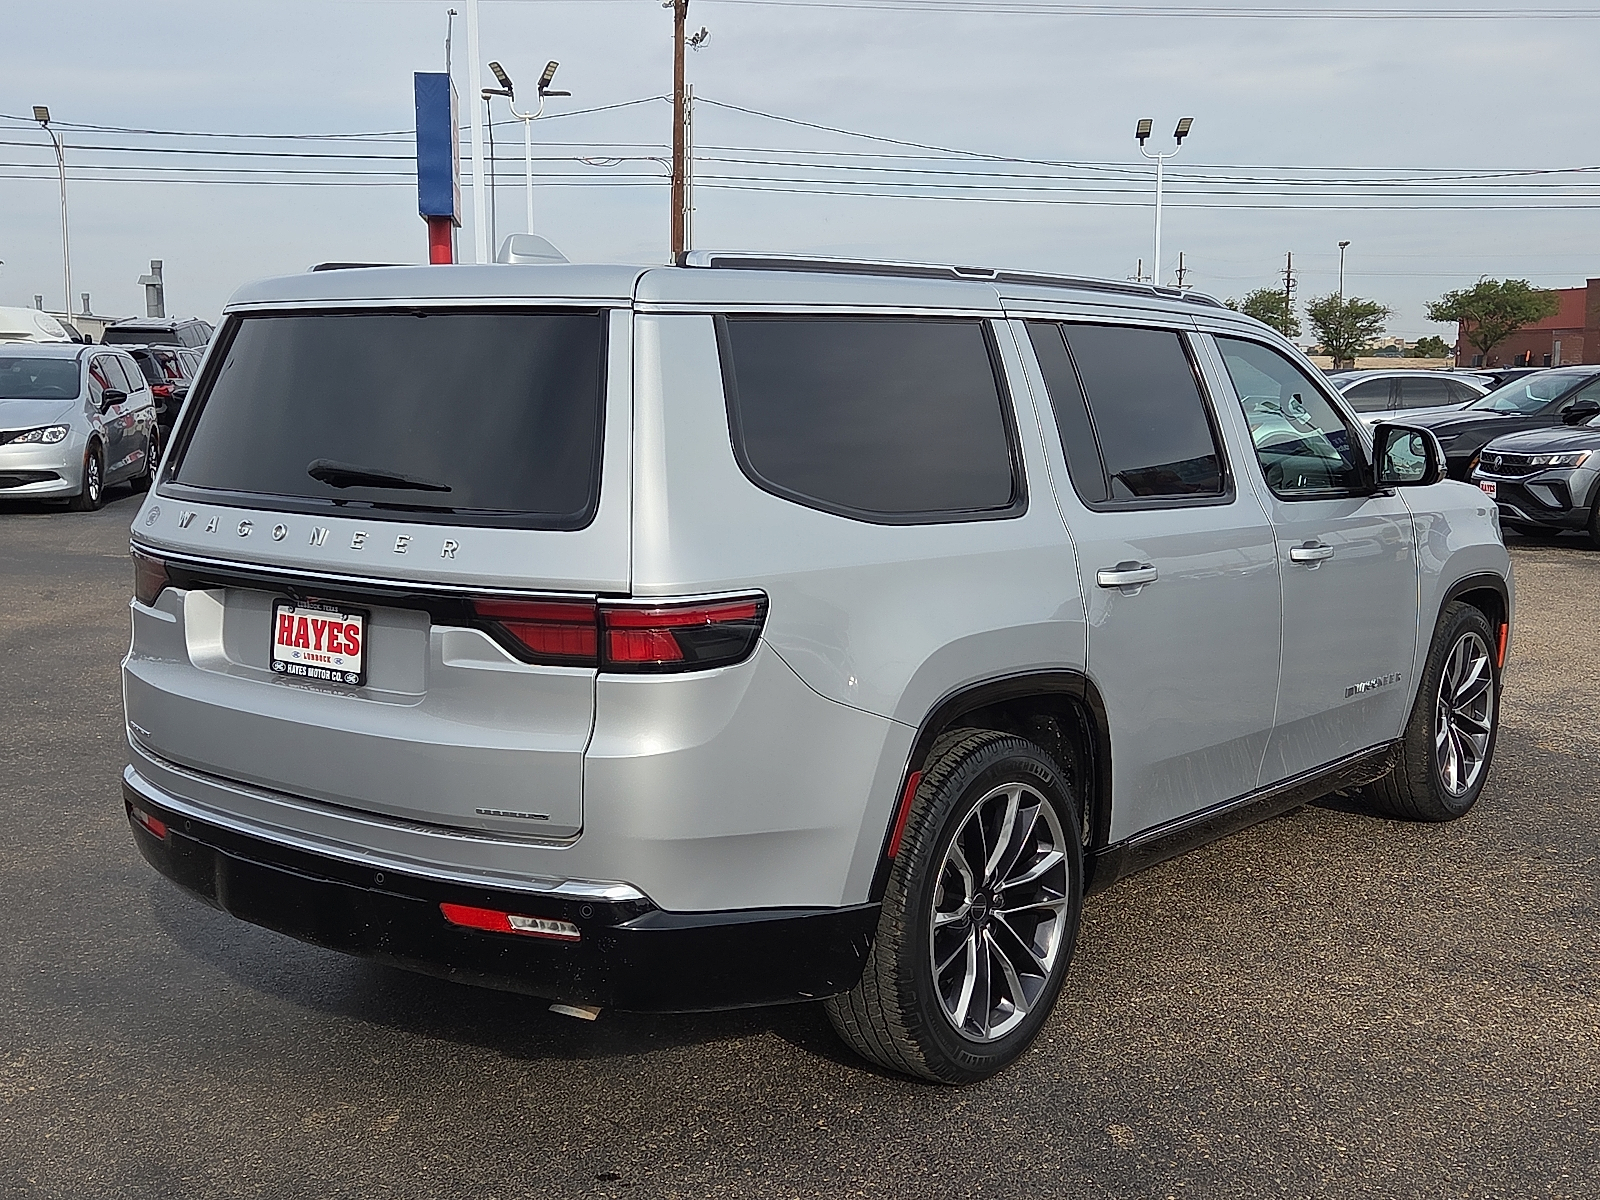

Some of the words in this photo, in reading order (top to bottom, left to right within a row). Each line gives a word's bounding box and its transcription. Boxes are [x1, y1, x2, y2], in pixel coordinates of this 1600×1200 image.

[178, 510, 460, 559] WAGONEER
[278, 614, 360, 656] HAYES
[303, 652, 332, 663] LUBBOCK
[287, 663, 307, 675] HAYES
[307, 667, 331, 680] MOTOR
[331, 672, 344, 682] CO.
[1344, 672, 1402, 698] WNEER
